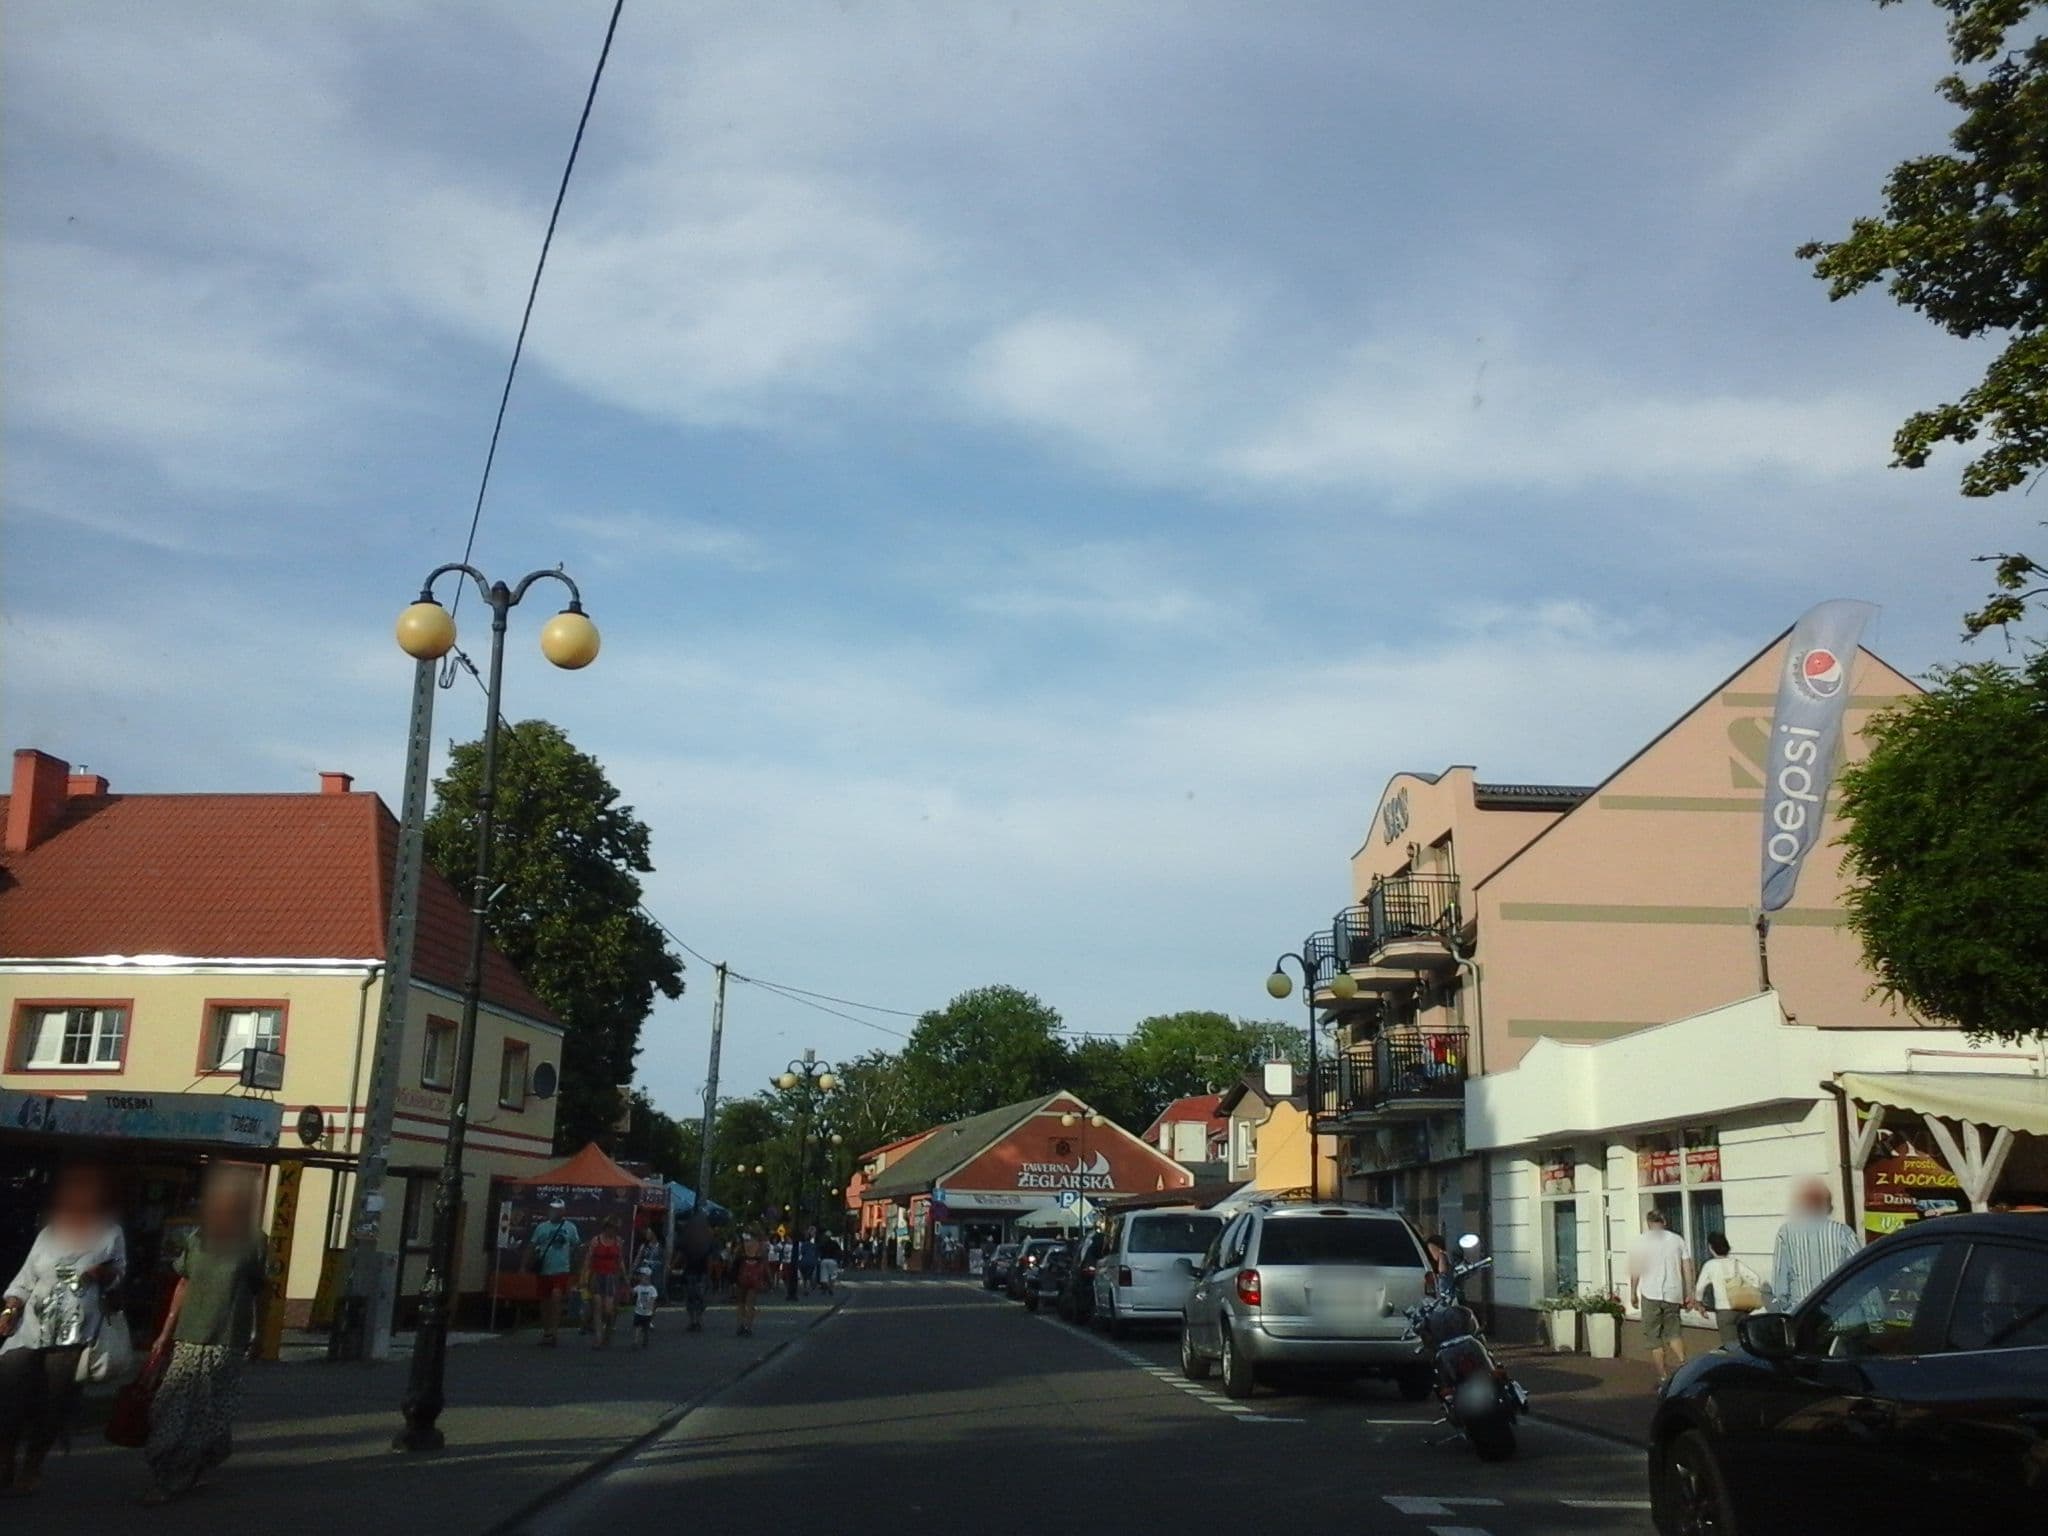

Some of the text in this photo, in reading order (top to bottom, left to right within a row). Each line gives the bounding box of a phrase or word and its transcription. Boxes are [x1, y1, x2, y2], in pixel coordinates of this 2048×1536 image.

[1768, 725, 1821, 866] pepsi
[1022, 1162, 1071, 1174] TAWERNA
[1875, 1172, 1958, 1188] z nocneg
[1063, 1192, 1075, 1208] P
